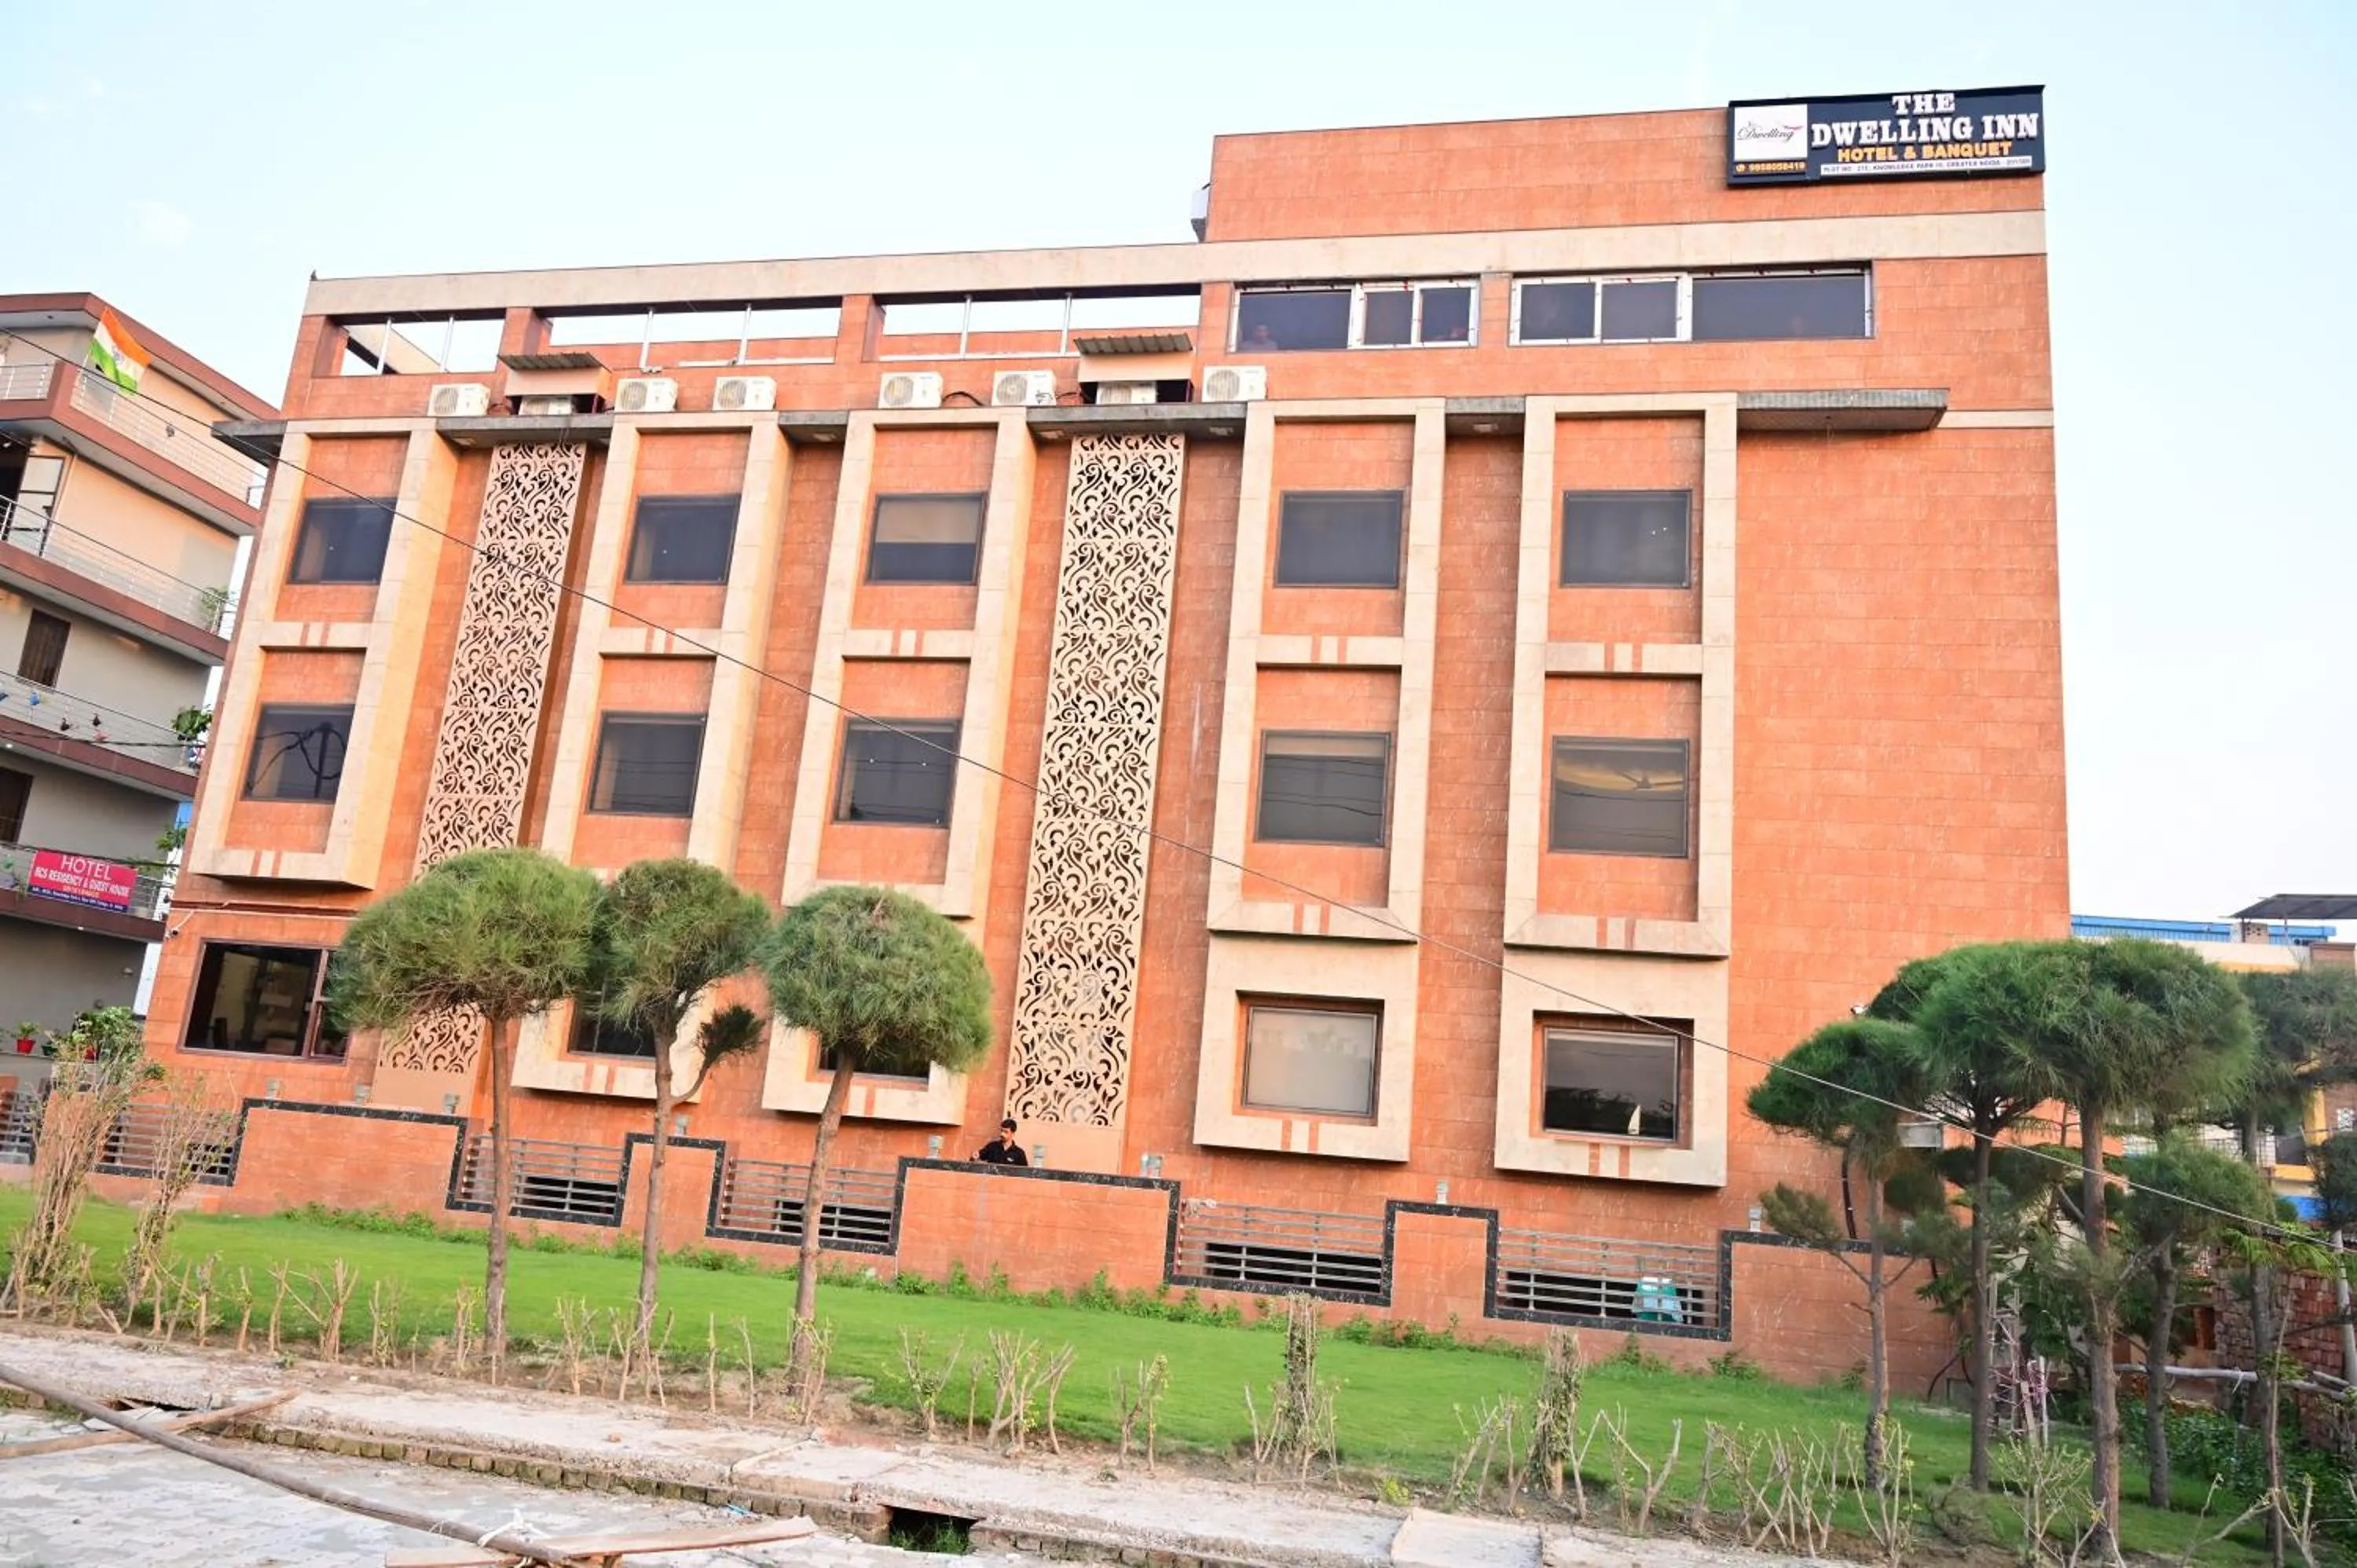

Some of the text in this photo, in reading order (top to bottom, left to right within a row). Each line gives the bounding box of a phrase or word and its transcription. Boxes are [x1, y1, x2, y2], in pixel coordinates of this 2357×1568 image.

[1893, 93, 1955, 115] THE
[1736, 124, 1795, 143] Dwelling
[1811, 113, 2039, 147] DWELLING INN
[1837, 141, 2012, 163] HOTEL & BANQUET
[61, 855, 112, 880] HOTEL
[90, 879, 110, 892] GUEST
[109, 884, 130, 896] HOUSE
